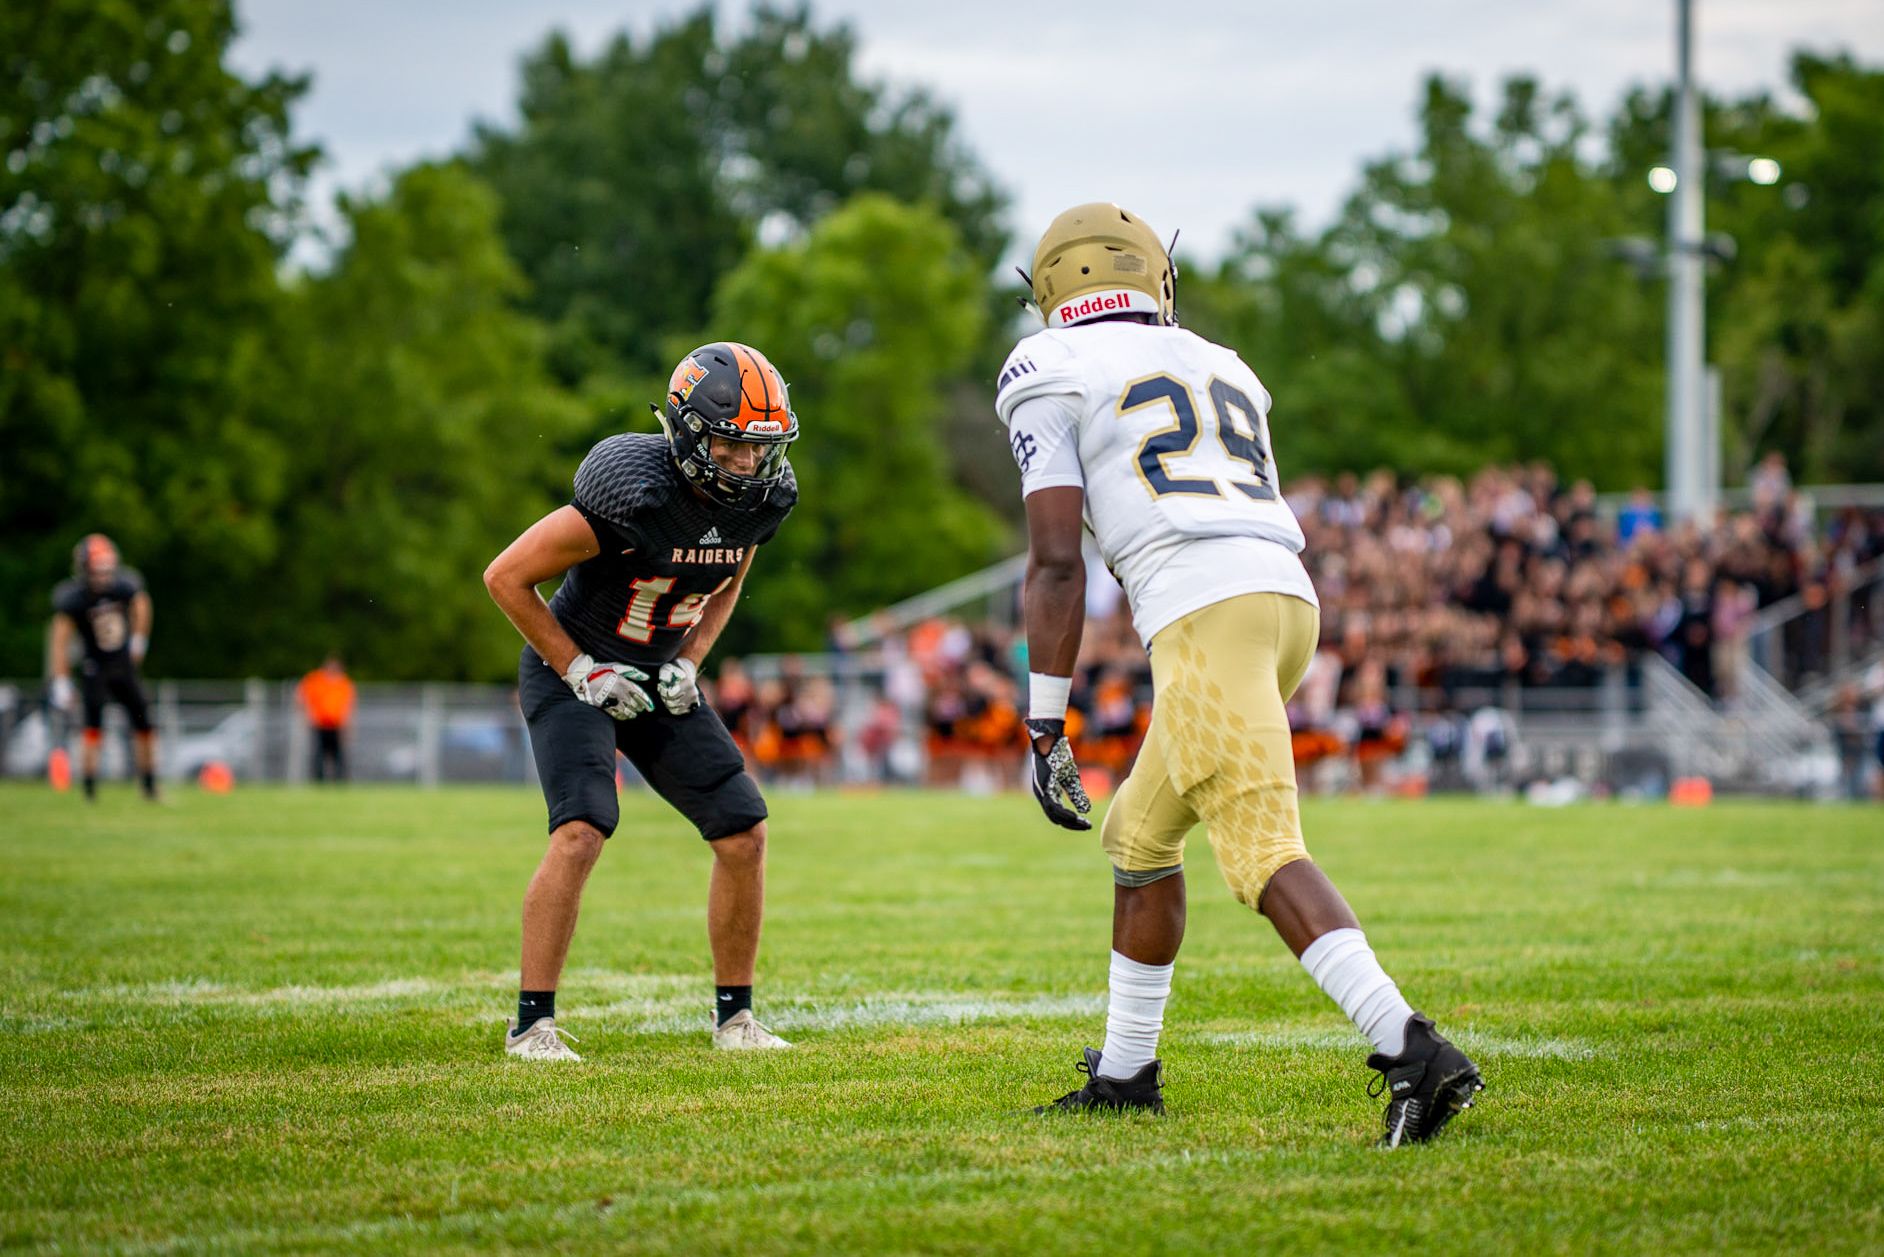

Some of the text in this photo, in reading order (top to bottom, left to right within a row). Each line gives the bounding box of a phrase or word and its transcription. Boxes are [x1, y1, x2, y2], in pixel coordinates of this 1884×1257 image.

[1060, 293, 1131, 323] Riddell
[752, 424, 780, 432] Riddell
[1115, 371, 1279, 503] 29
[699, 537, 722, 545] adidas
[671, 547, 744, 564] RAIDERS
